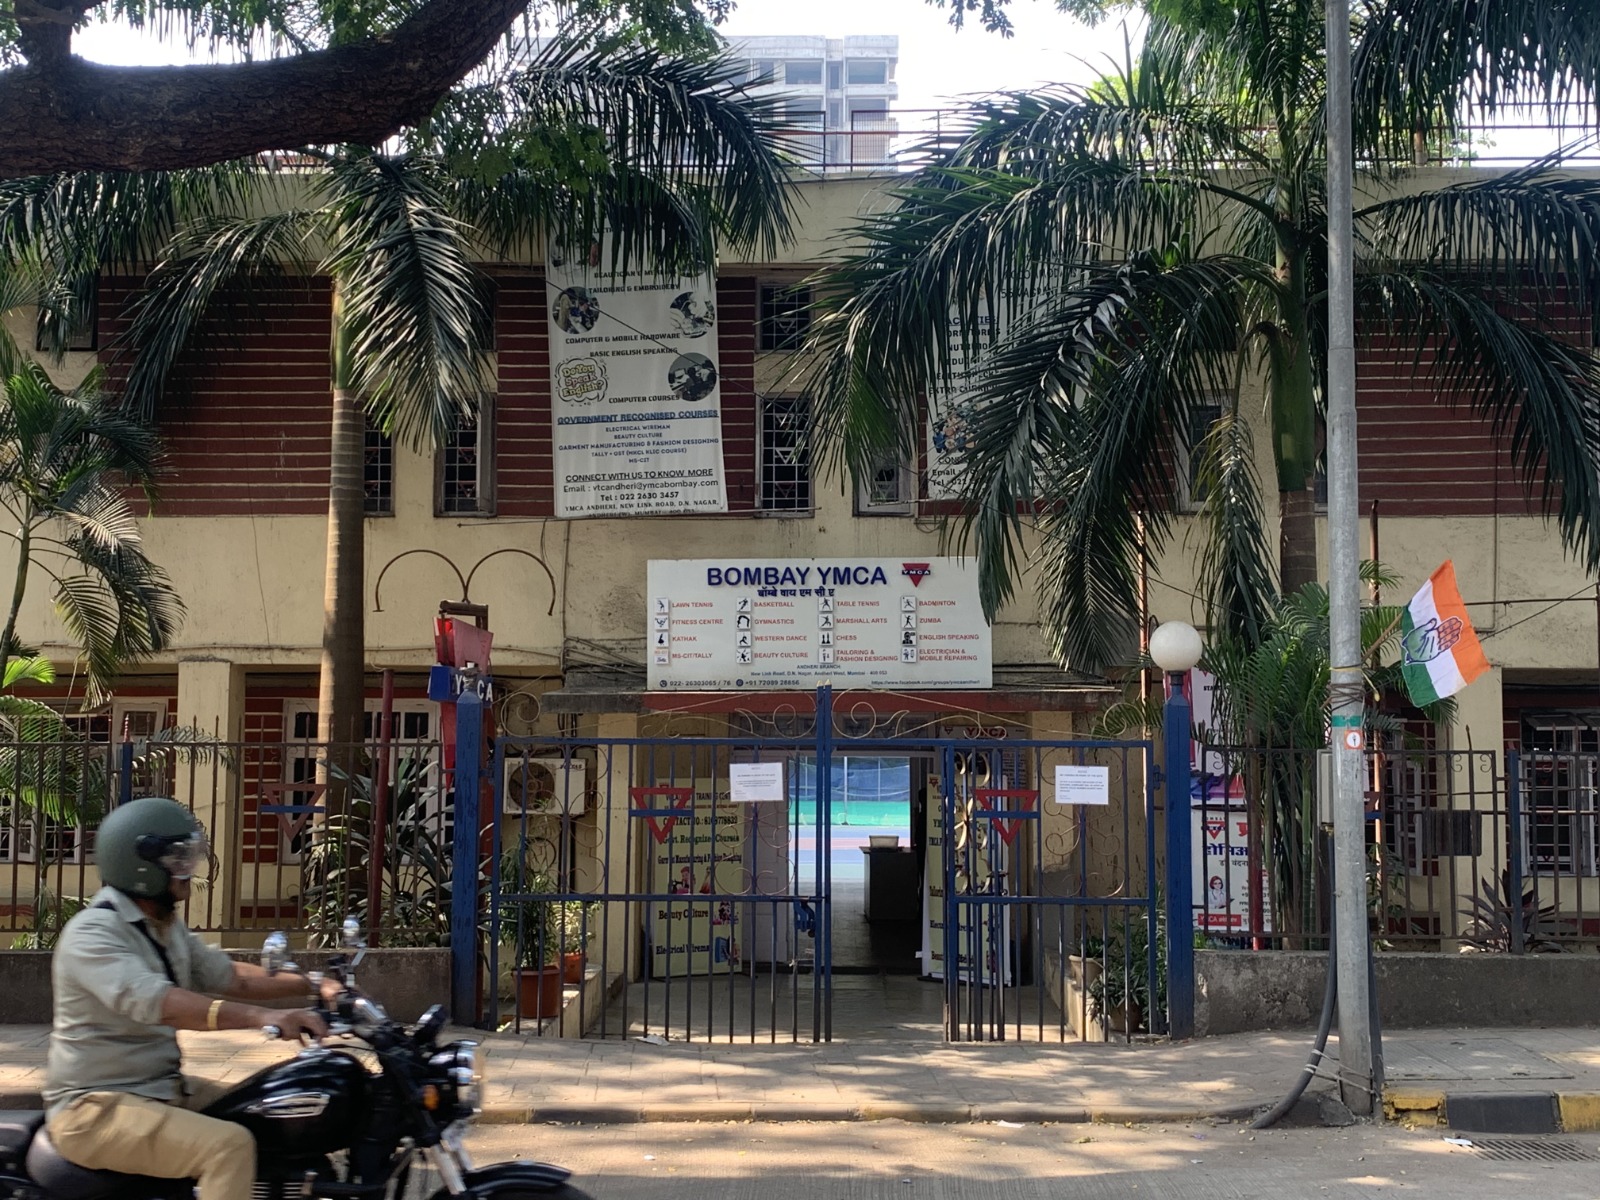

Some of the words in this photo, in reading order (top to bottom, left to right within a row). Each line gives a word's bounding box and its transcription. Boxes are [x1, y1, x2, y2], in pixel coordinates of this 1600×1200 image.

[640, 333, 680, 341] HARDWARE
[562, 368, 576, 377] Do
[576, 364, 595, 374] You
[565, 373, 597, 387] Speak
[562, 380, 604, 397] English?
[557, 414, 618, 424] GOVERNMENT
[620, 412, 675, 422] RECOGNISED
[678, 410, 719, 419] COURSES
[566, 474, 606, 482] CONNECT
[657, 470, 685, 478] KNOW
[564, 485, 585, 493] Email
[593, 480, 719, 492] vtcandheri@ymcabombay.com
[707, 567, 810, 586] BOMBAY
[817, 566, 887, 585] YMCA
[758, 586, 777, 597] बॉम्बे
[781, 588, 796, 597] वाय
[799, 588, 811, 597] एम
[815, 586, 825, 596] सी
[828, 588, 835, 596] ए
[456, 674, 493, 702] YCA
[680, 834, 713, 845] Recgnize
[659, 910, 682, 921] Beuty
[684, 909, 708, 918] Clture
